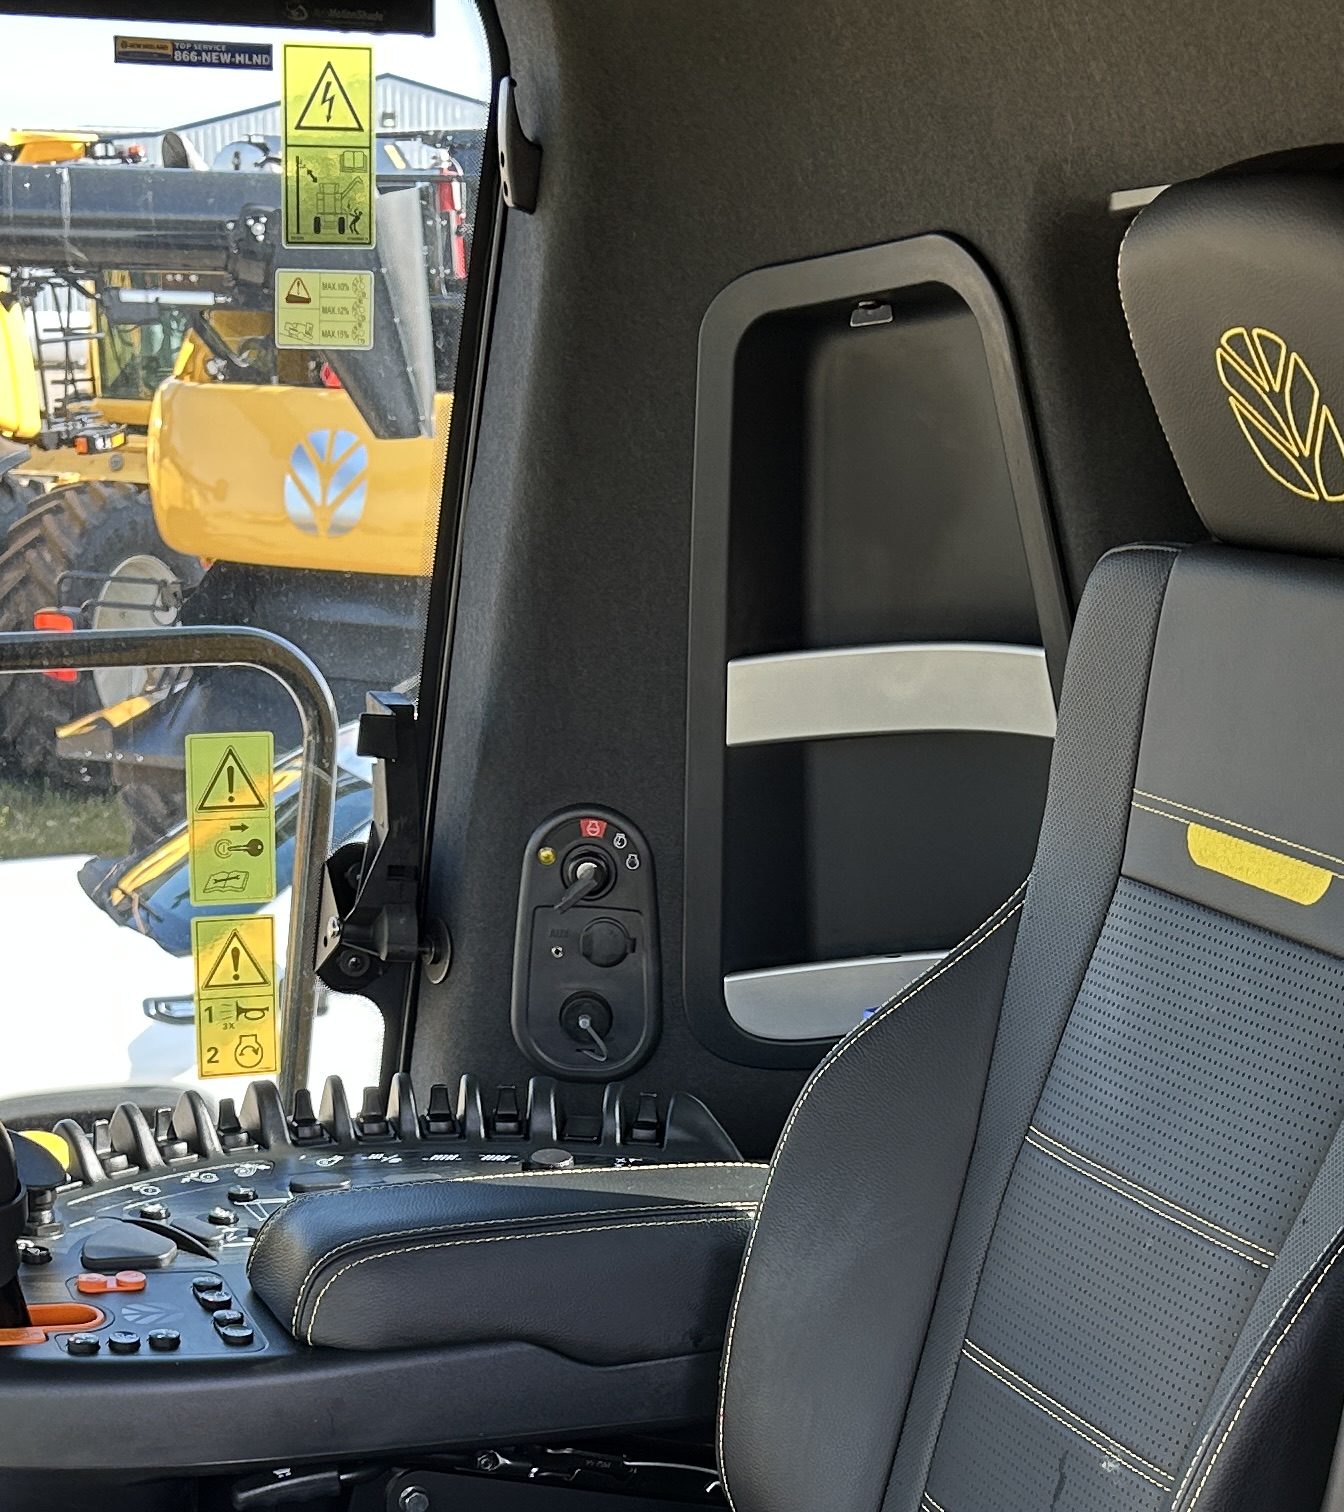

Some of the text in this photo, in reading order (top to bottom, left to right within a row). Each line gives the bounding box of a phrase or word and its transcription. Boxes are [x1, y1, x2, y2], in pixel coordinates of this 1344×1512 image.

[204, 1005, 214, 1023] 1
[222, 1022, 235, 1030] 3X
[206, 1046, 219, 1065] 2
